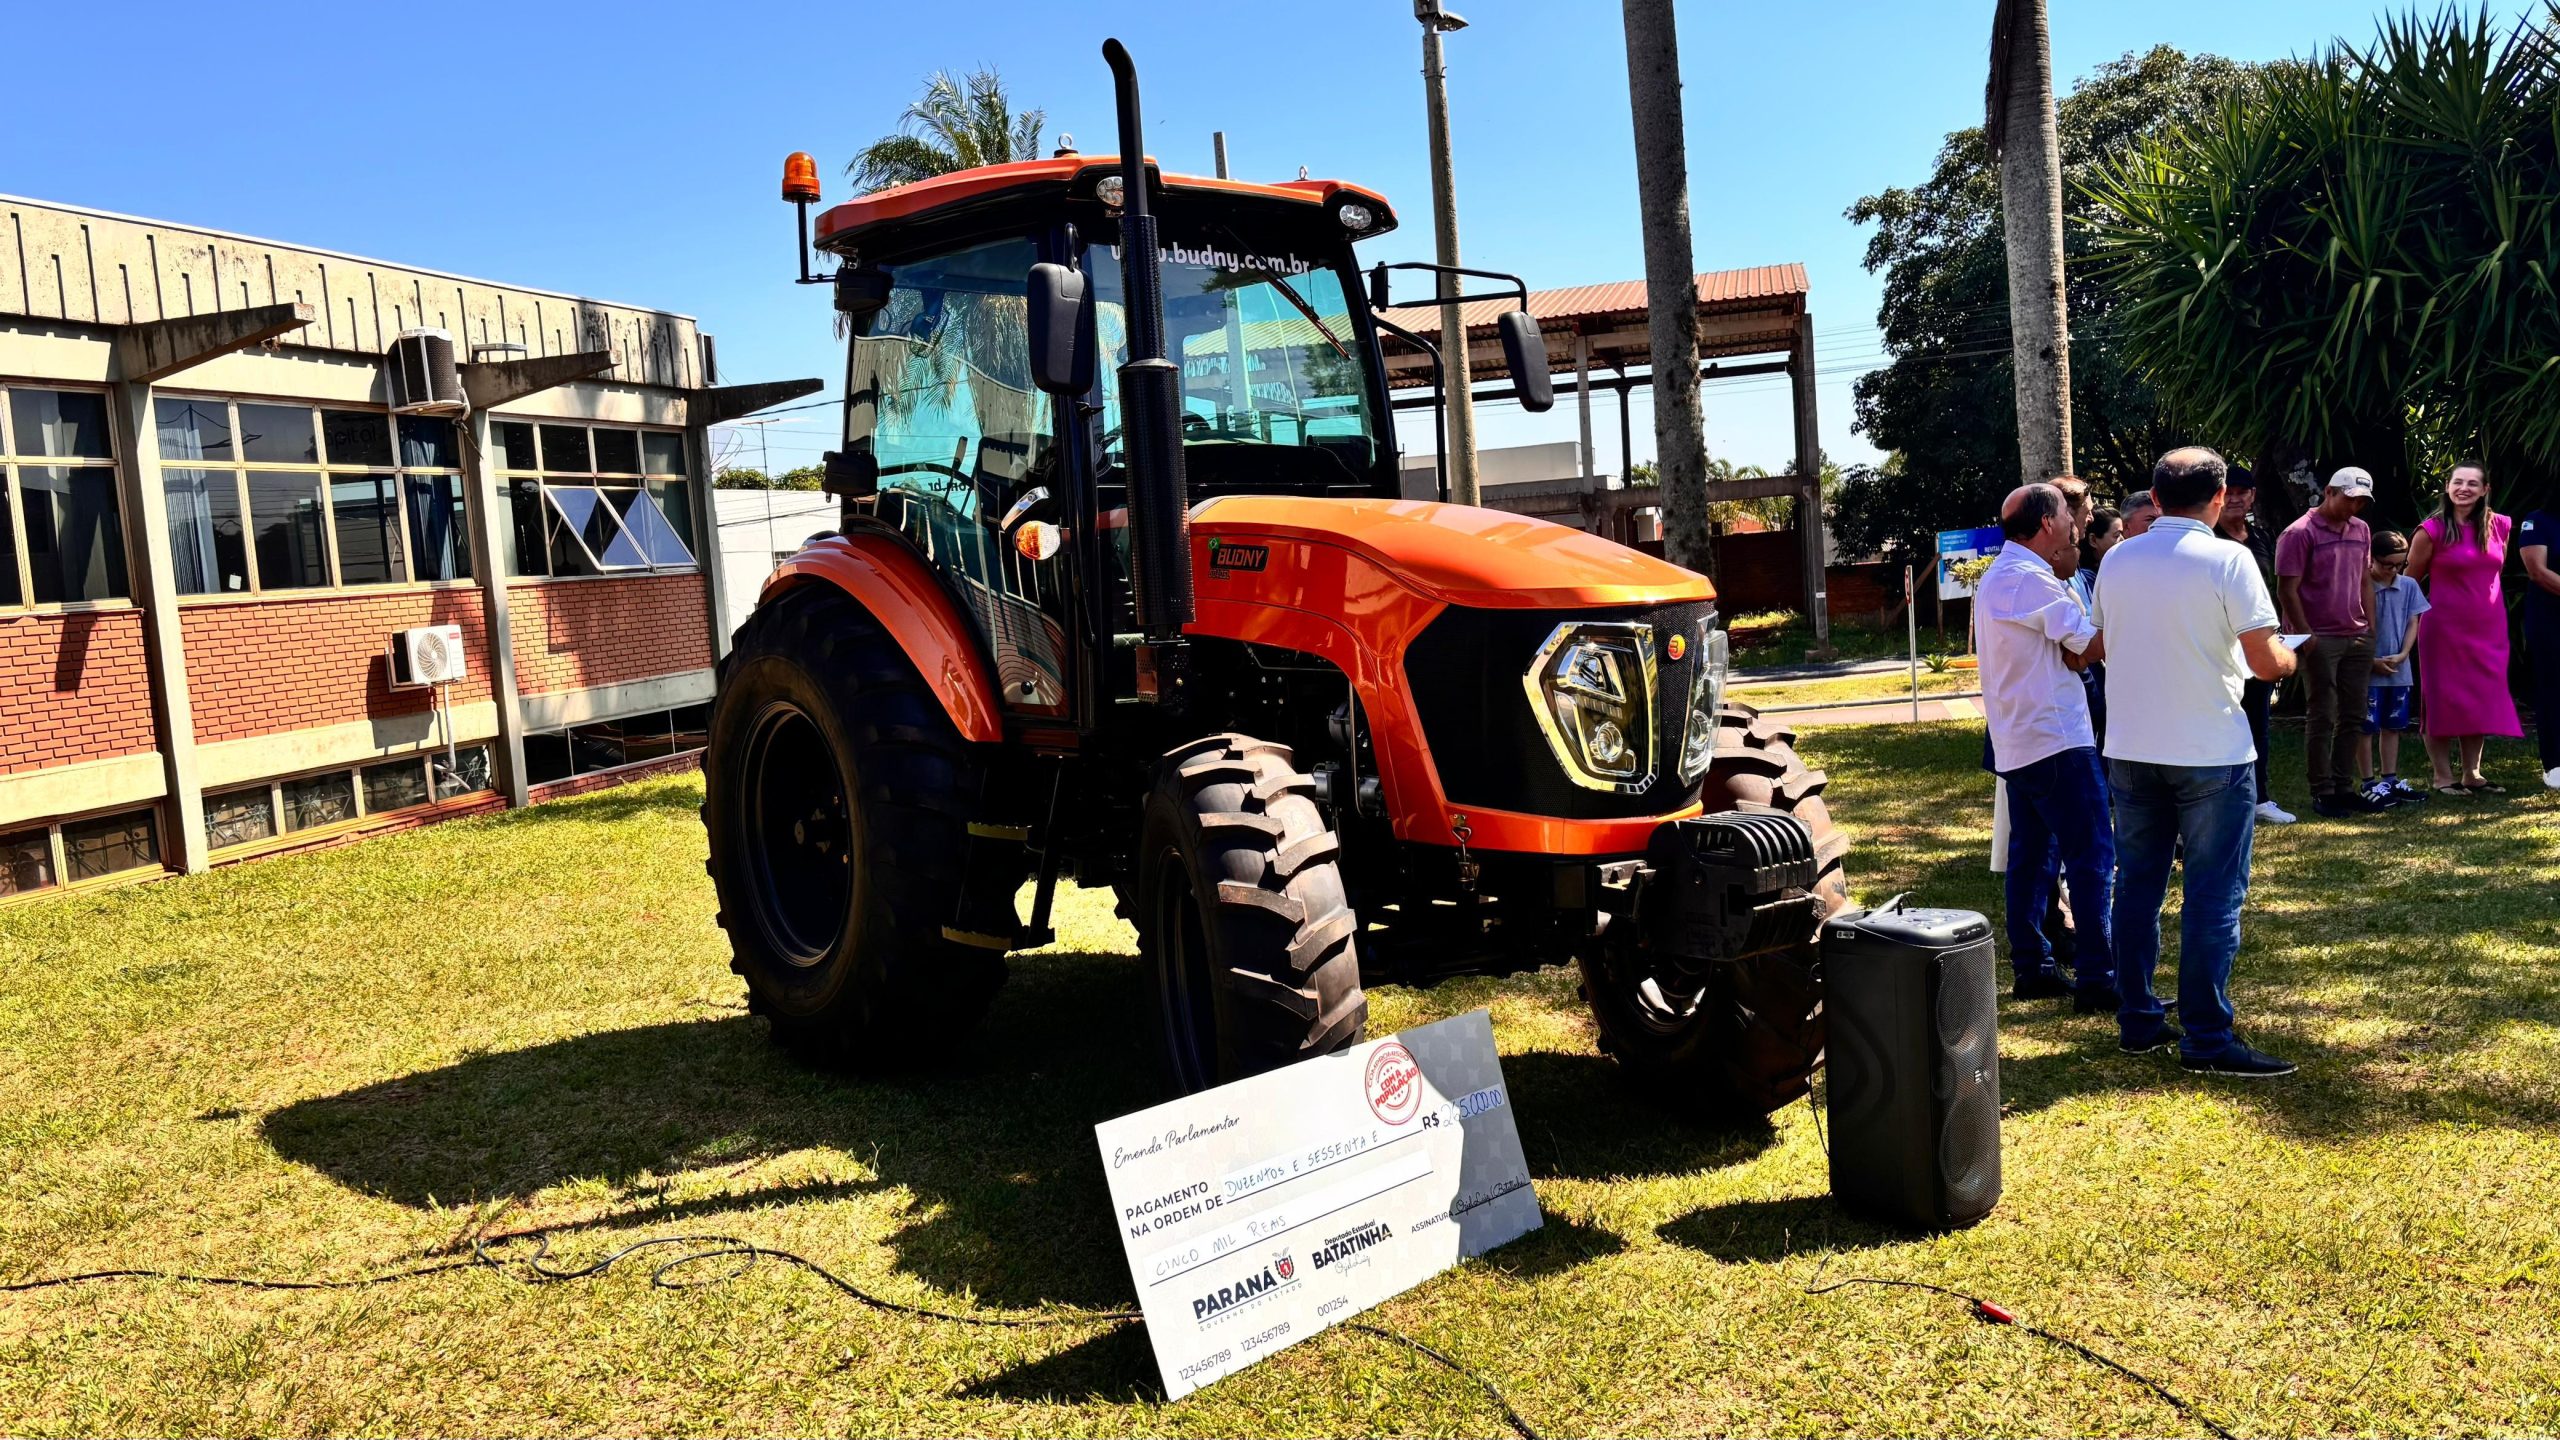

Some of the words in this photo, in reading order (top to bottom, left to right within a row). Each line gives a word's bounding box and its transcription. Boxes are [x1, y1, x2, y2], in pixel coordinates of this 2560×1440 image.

[1217, 548, 1265, 567] BUDNY
[1367, 1050, 1409, 1088] COMPROMISSO
[1380, 1073, 1396, 1091] COM
[1395, 1069, 1402, 1078] A
[1422, 1111, 1440, 1130] R$
[1114, 1136, 1163, 1169] Emenda
[1165, 1115, 1240, 1149] Parlamentar
[1293, 1160, 1299, 1172] E
[1308, 1137, 1366, 1167] SESSENTA
[1372, 1130, 1378, 1143] E
[1126, 1181, 1209, 1221] PAGAMENTO
[1130, 1223, 1151, 1239] NA
[1154, 1202, 1202, 1230] ORDEM
[1205, 1195, 1224, 1211] DE
[1411, 1209, 1454, 1234] ASSINATURA
[1156, 1249, 1199, 1276] CINCO
[1213, 1234, 1237, 1253] MIL
[1247, 1215, 1286, 1237] REAIS
[1312, 1223, 1393, 1270] BATATINHA
[1324, 1230, 1352, 1246] Deputado
[1351, 1218, 1376, 1234] Estadual
[1193, 1265, 1278, 1319] PARANÁ
[1200, 1308, 1244, 1332] GOVERNO
[1251, 1300, 1262, 1309] DO
[1268, 1282, 1302, 1302] ESTADO
[1179, 1349, 1232, 1381] 123456789
[1241, 1321, 1291, 1352] 123456789
[1317, 1295, 1349, 1317] 001254
